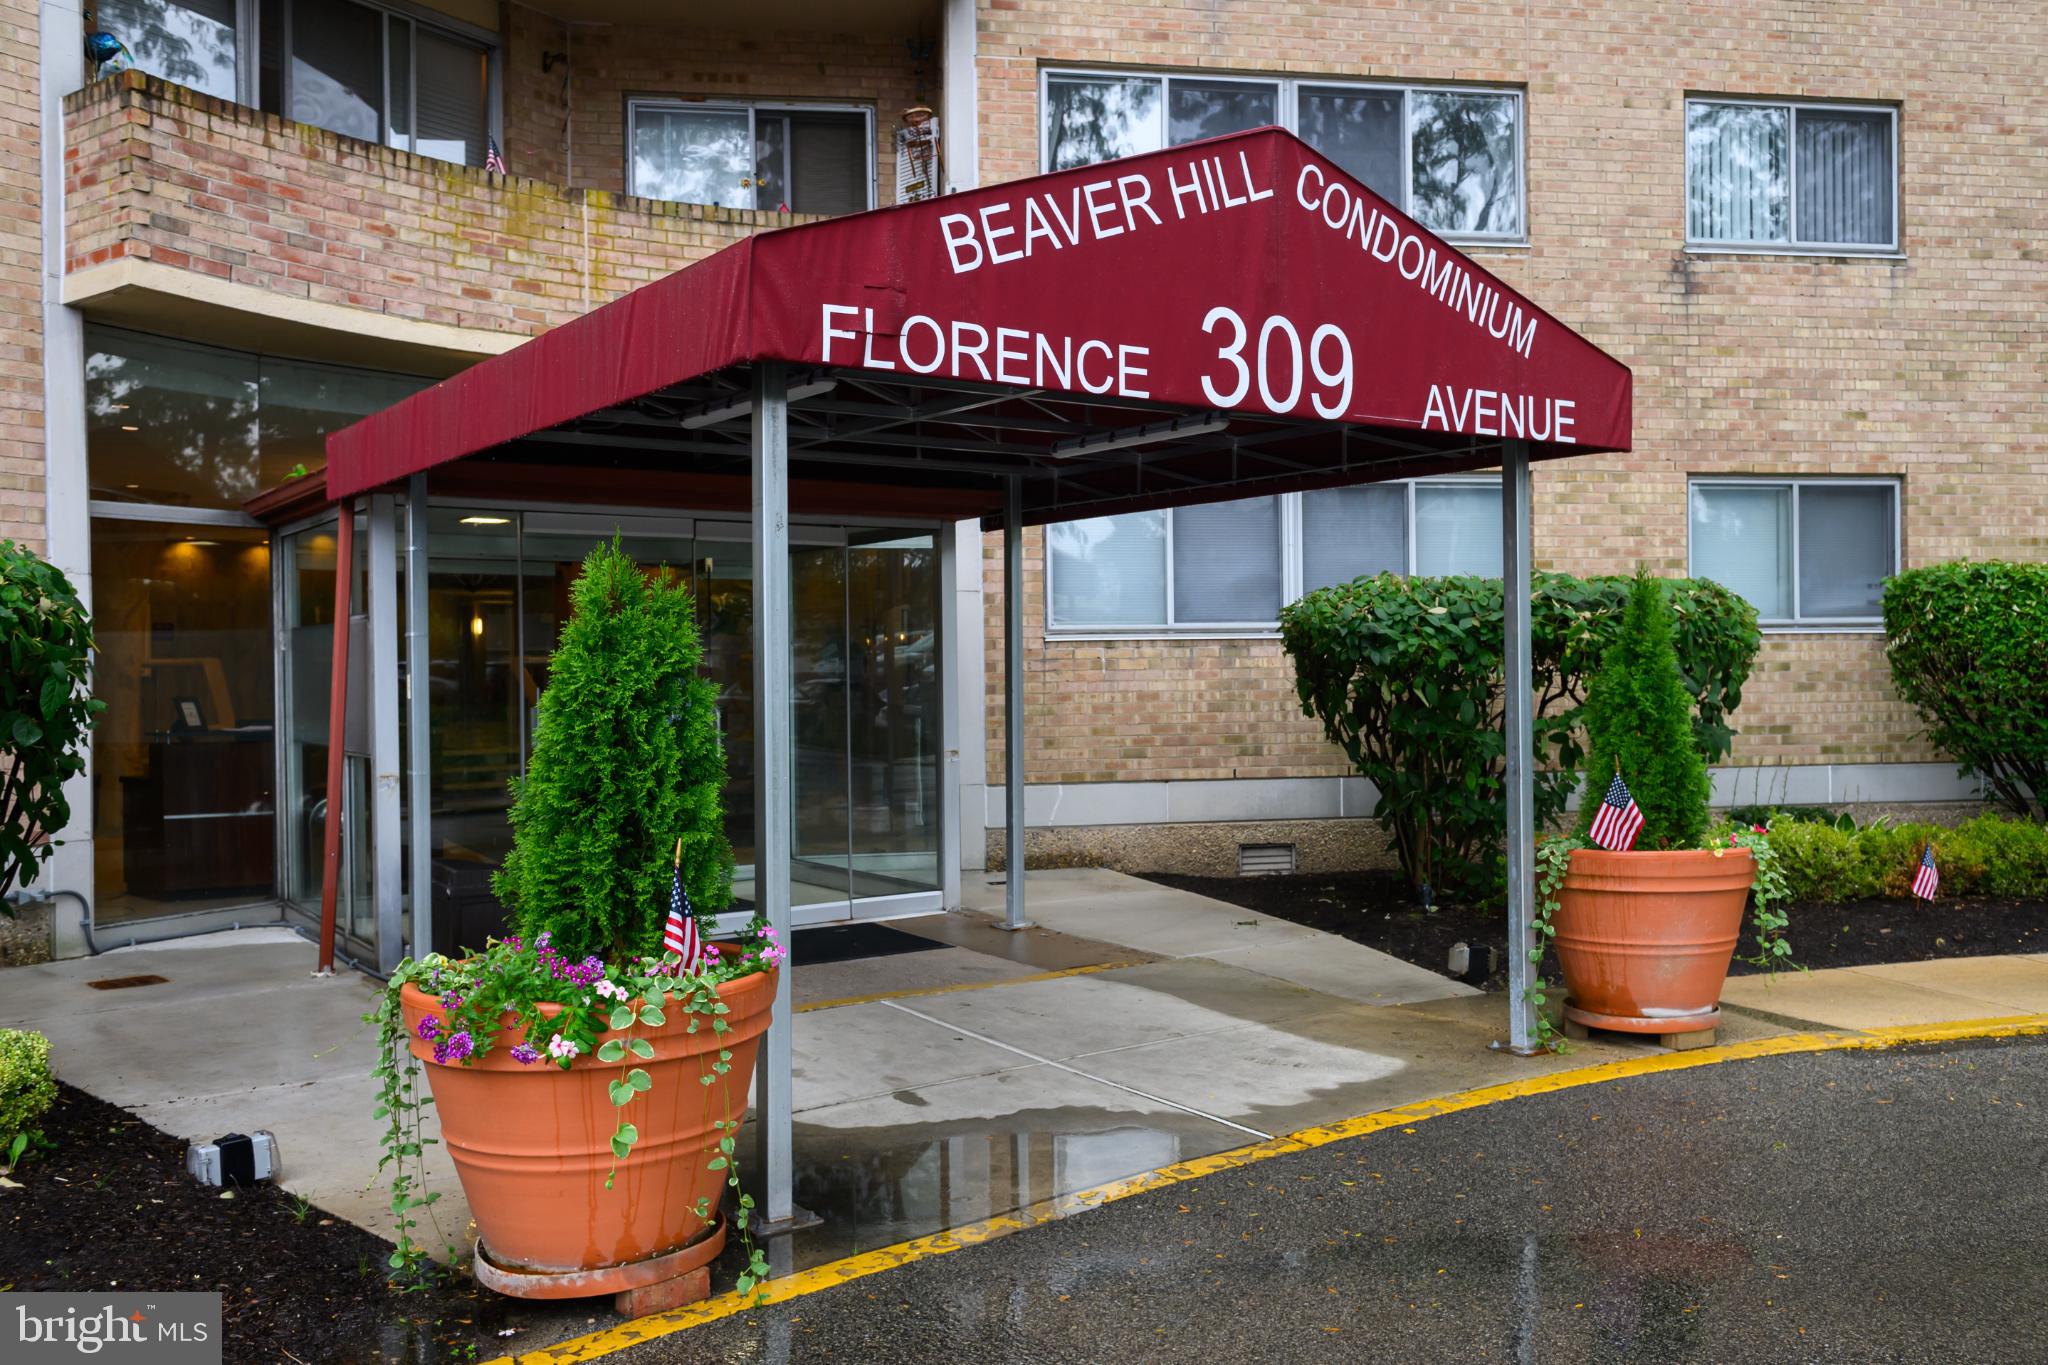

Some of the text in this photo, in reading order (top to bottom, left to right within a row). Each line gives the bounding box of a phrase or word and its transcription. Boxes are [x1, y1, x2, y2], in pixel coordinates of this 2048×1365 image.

[939, 151, 1274, 274] BEAVER HILL
[1296, 164, 1538, 359] CONDOMINIUM
[822, 303, 1576, 444] FLORENCE 309 AVENUE
